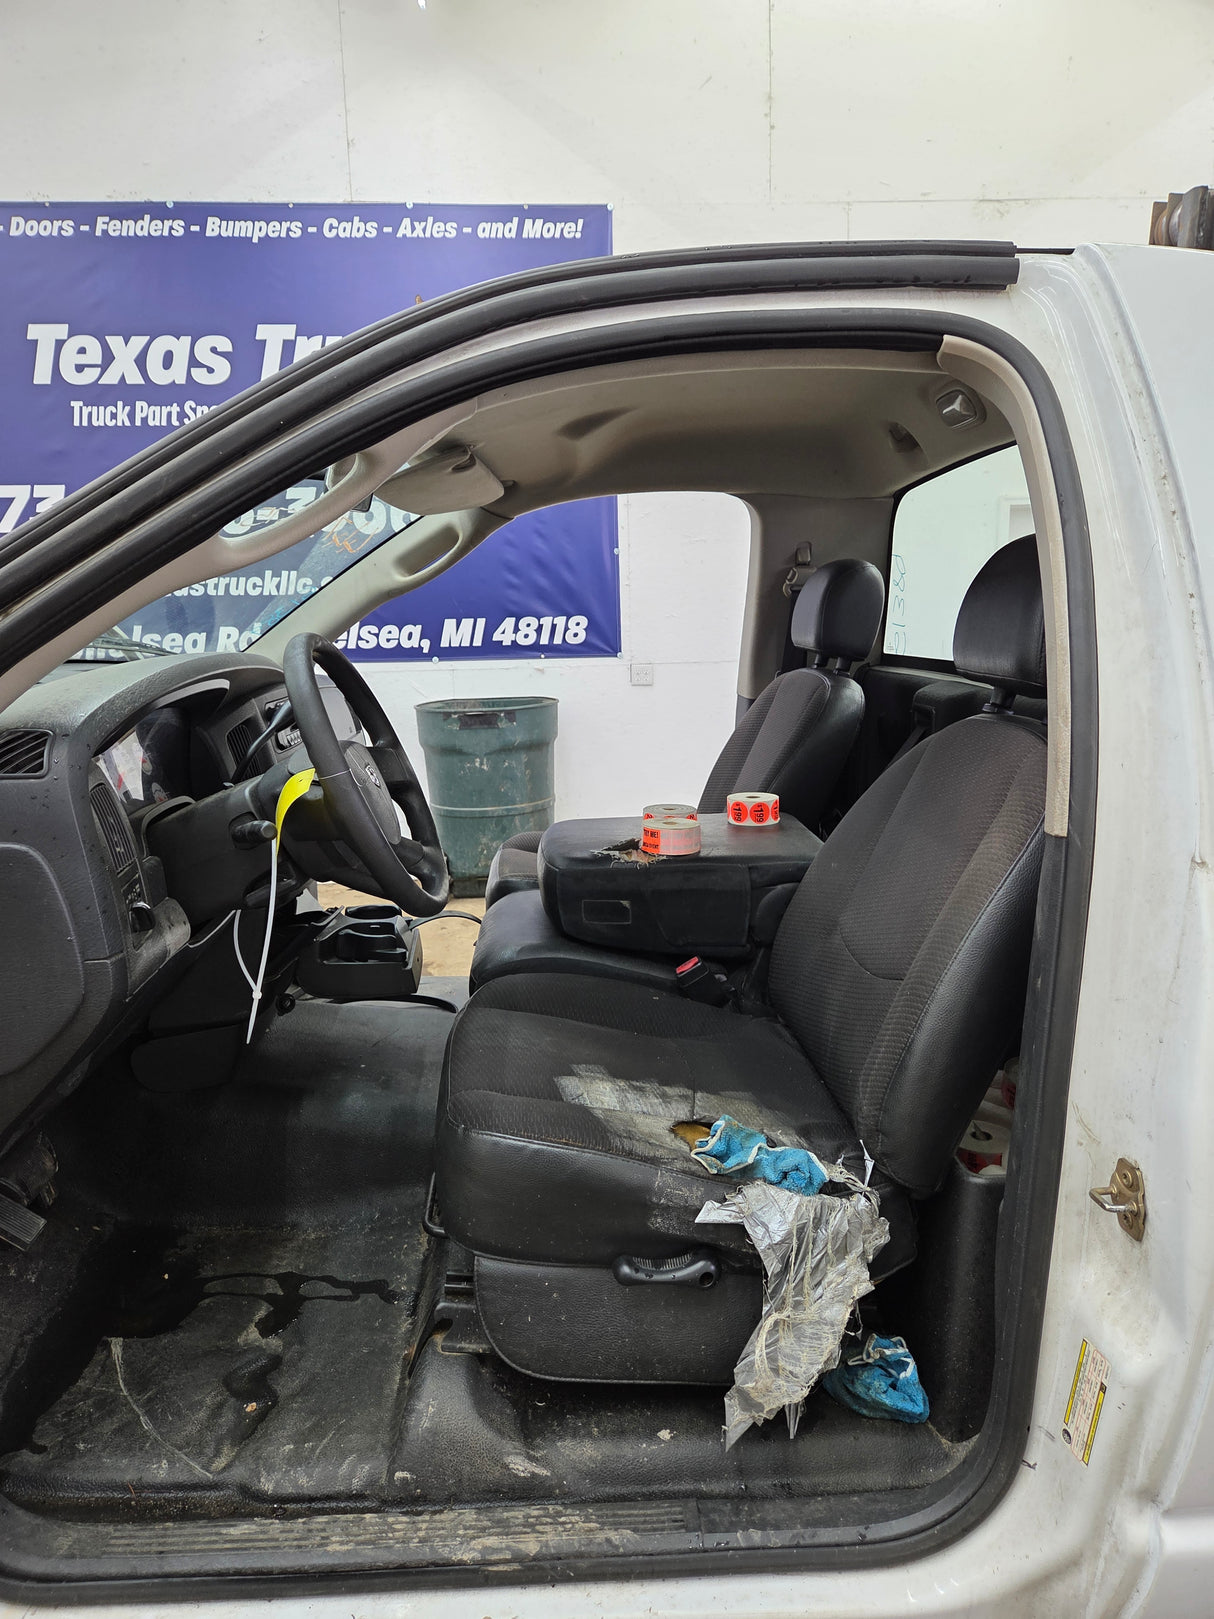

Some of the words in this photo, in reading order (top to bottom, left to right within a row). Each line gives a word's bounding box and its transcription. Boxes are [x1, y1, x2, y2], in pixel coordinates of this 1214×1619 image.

[9, 216, 74, 237] Doors
[95, 214, 185, 237] Fenders
[205, 216, 303, 243] Bumpers
[322, 216, 378, 239] Cabs
[396, 216, 457, 239] Axles
[477, 217, 518, 239] and
[522, 218, 584, 239] More!
[26, 323, 233, 386] Texas
[255, 323, 343, 382] Tr
[70, 400, 131, 427] Truck
[135, 401, 180, 427] Part
[183, 400, 219, 425] Sp
[332, 621, 431, 653] elsea,
[440, 618, 487, 648] MI
[492, 615, 588, 646] 48118
